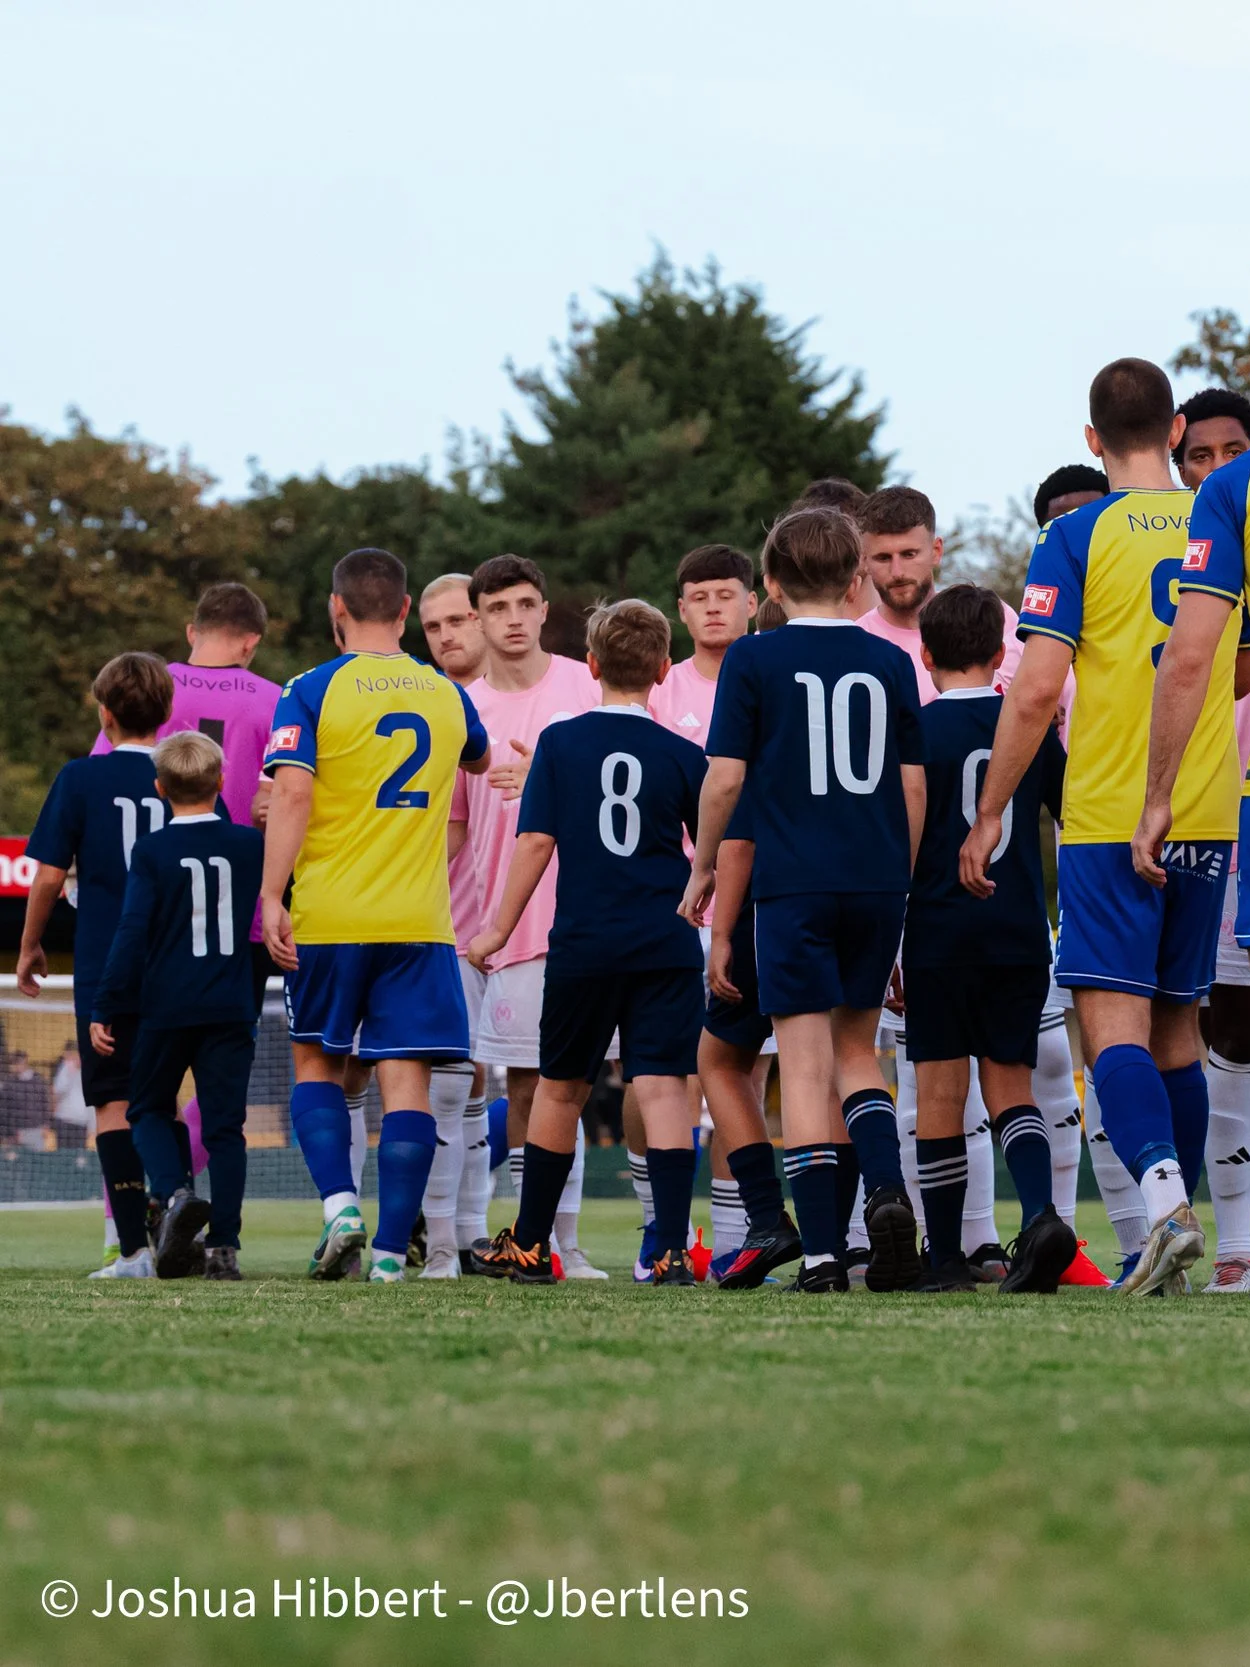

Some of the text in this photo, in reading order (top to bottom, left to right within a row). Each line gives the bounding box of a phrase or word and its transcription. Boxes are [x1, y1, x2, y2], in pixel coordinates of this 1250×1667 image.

[355, 674, 436, 694] Novelis
[795, 671, 888, 795] 10
[375, 712, 432, 809] 2
[599, 751, 643, 857] 8
[180, 856, 234, 957] 11
